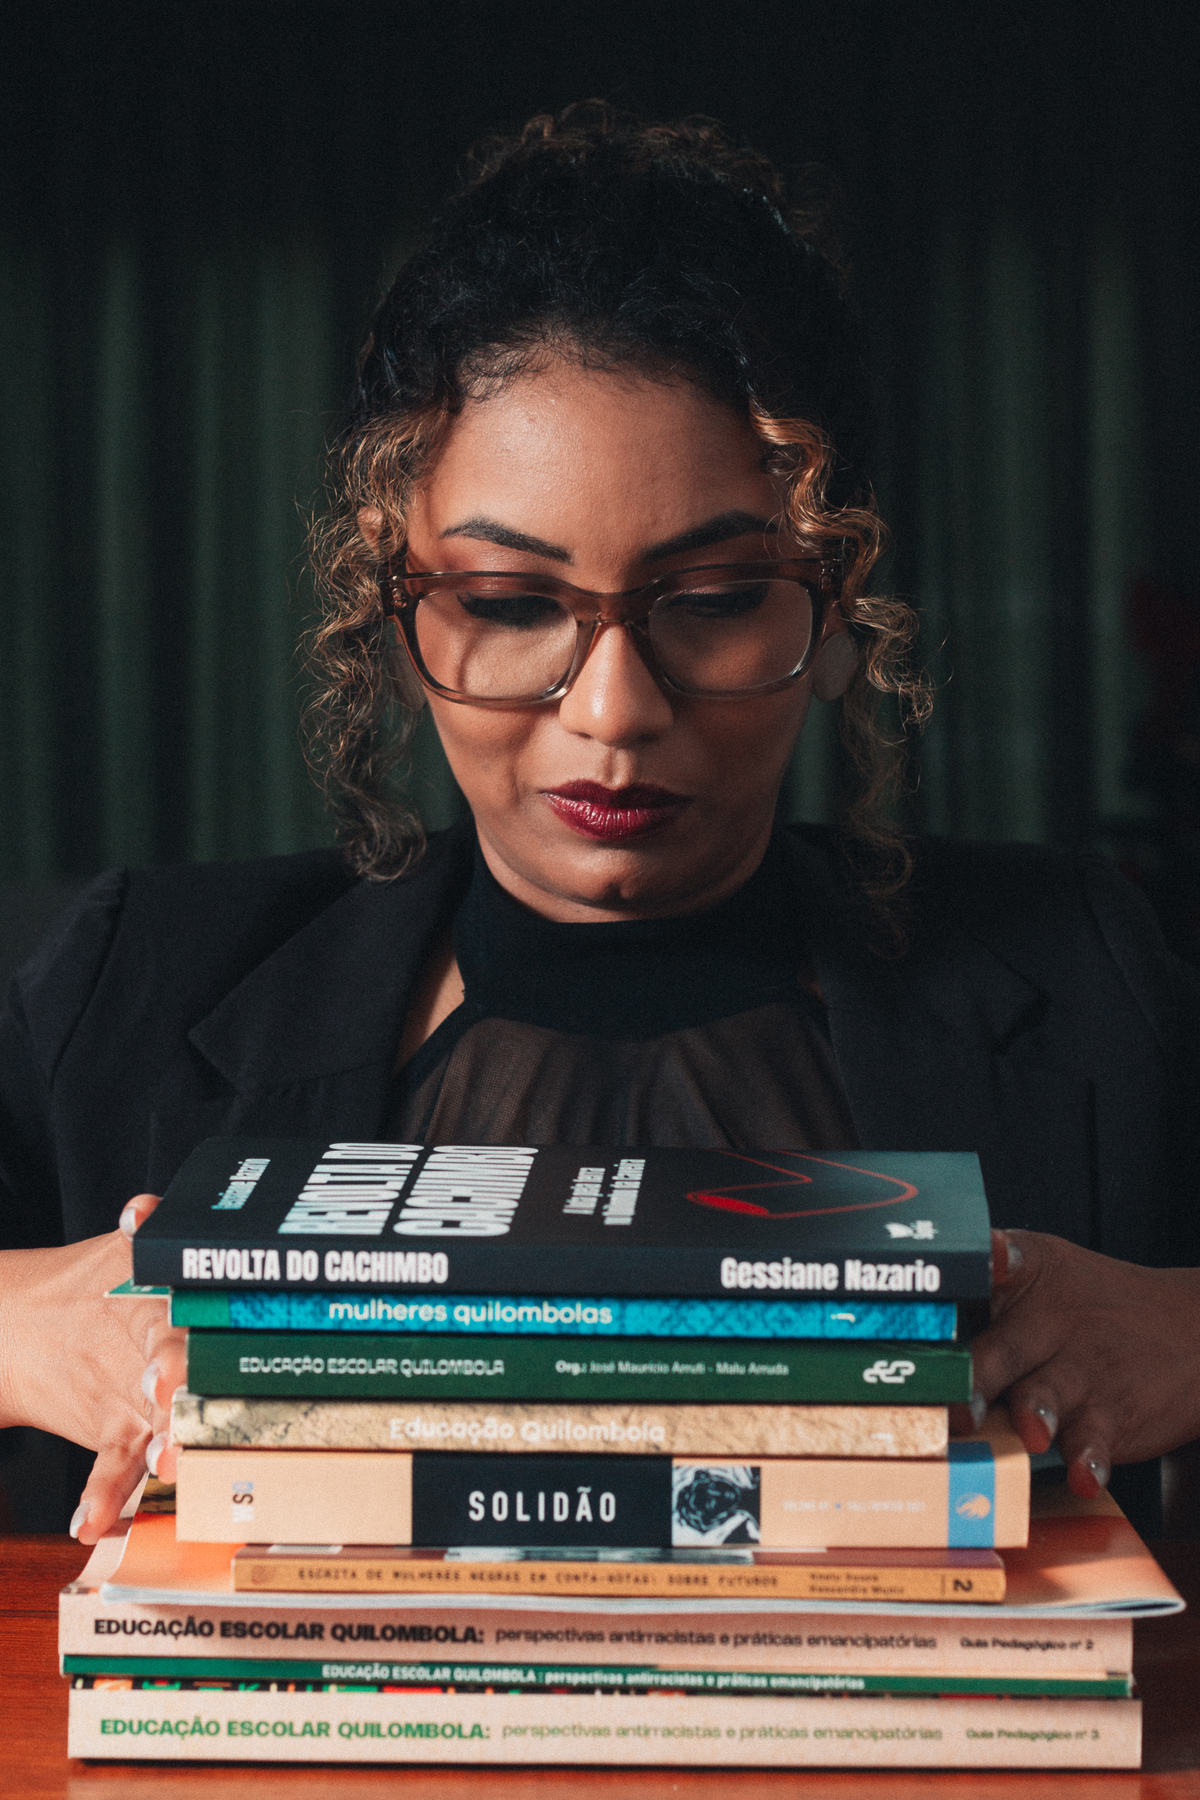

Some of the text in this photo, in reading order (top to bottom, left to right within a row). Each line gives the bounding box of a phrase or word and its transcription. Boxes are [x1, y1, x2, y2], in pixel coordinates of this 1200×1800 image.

[278, 1143, 424, 1235] REVOLTA DO
[393, 1145, 539, 1236] CACHIMBO
[182, 1248, 449, 1284] REVOLTA DO CACHIMBO
[721, 1256, 941, 1292] Gessiane Nazario
[329, 1298, 613, 1326] mulheres quilombolas
[239, 1354, 505, 1378] EDUCAÇÃO ESCOLAR QUILOMBOLA
[555, 1360, 588, 1376] Org.:
[390, 1416, 666, 1445] Educação Quilombola
[468, 1486, 616, 1522] SOLIDÃO
[298, 1568, 357, 1580] ESCRITA
[366, 1569, 382, 1580] DE
[953, 1579, 974, 1592] 2
[94, 1615, 937, 1651] EDUCAÇÃO ESCOLAR QUILOMBOLA: perspectivas antirracistas e práticas emancipatórias
[321, 1663, 390, 1681] EDUCAÇÃO
[392, 1666, 452, 1681] ESCOLAR
[545, 1670, 623, 1686] perspectivas
[626, 1672, 704, 1687] antirracistas
[706, 1676, 715, 1687] e
[717, 1673, 768, 1690] práticas
[769, 1674, 865, 1691] emancipatórias
[101, 1716, 942, 1742] EDUCAÇÃO ESCOLAR QUILOMBOLA: perspectivas antirracistas e práticas emancipatórias
